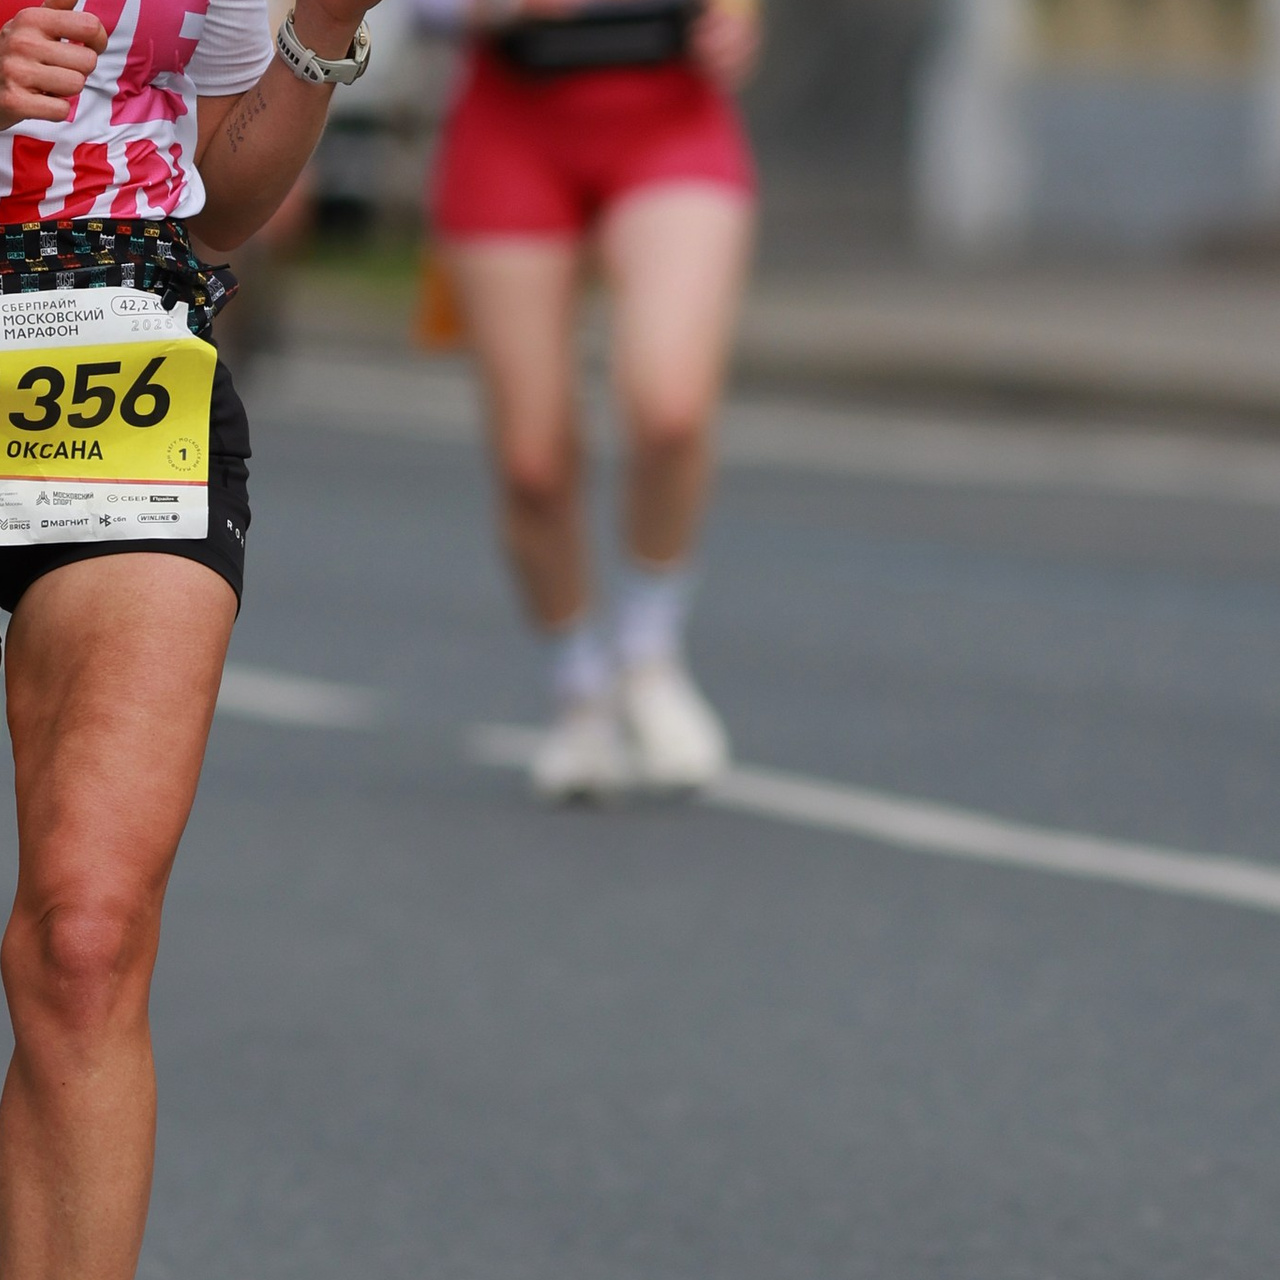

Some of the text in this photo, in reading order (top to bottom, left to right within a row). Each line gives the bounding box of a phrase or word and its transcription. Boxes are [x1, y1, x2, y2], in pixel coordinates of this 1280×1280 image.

[2, 299, 76, 313] СБЕРПРАЙМ
[120, 300, 149, 312] 42,2
[3, 307, 104, 326] МОСКОВСКИЙ
[4, 325, 78, 340] МАРАФОН
[7, 440, 103, 460] ОКСАНА
[179, 448, 187, 461] 1
